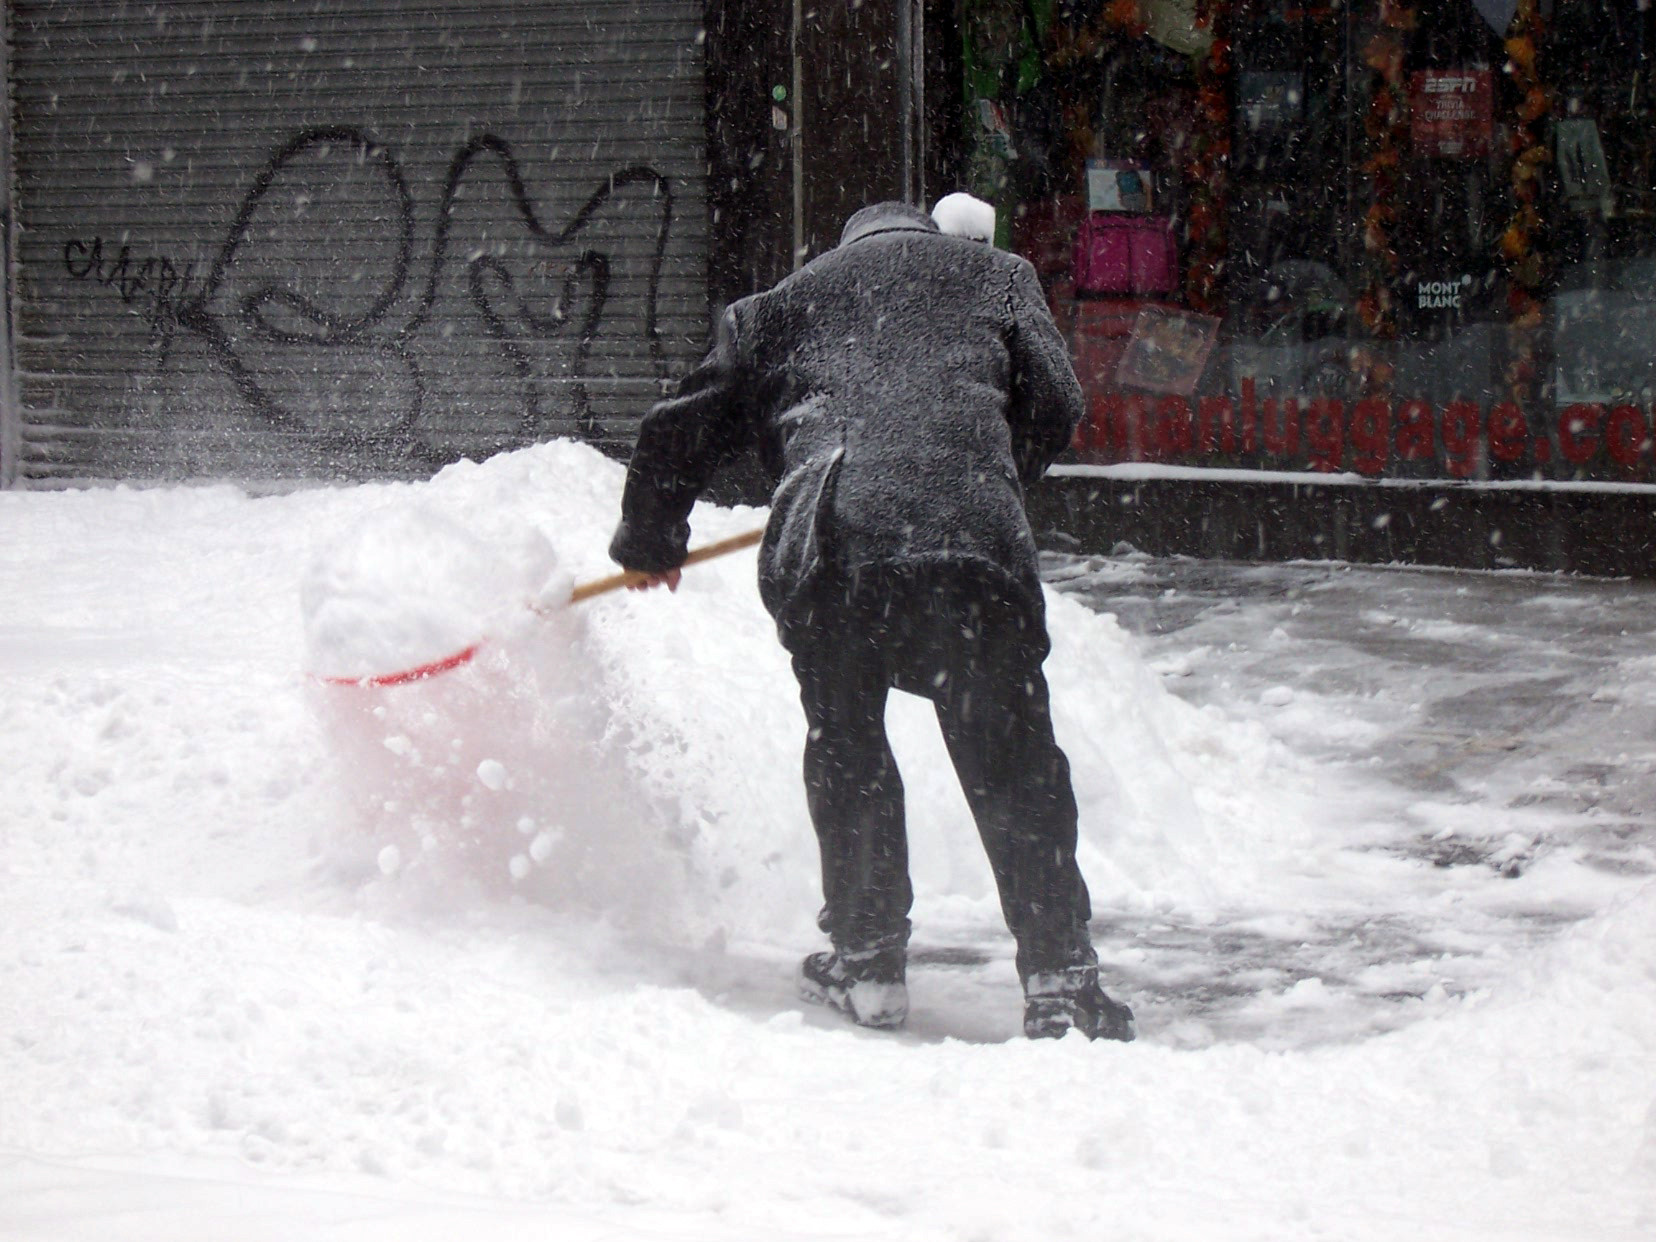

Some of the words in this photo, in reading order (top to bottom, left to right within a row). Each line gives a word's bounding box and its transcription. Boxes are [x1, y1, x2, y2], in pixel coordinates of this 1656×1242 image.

[1424, 77, 1477, 93] ESPN
[1435, 99, 1465, 109] TRIVIA
[1418, 281, 1461, 295] MONT
[1418, 295, 1461, 309] BLANC
[1072, 376, 1656, 477] manluggage.co
